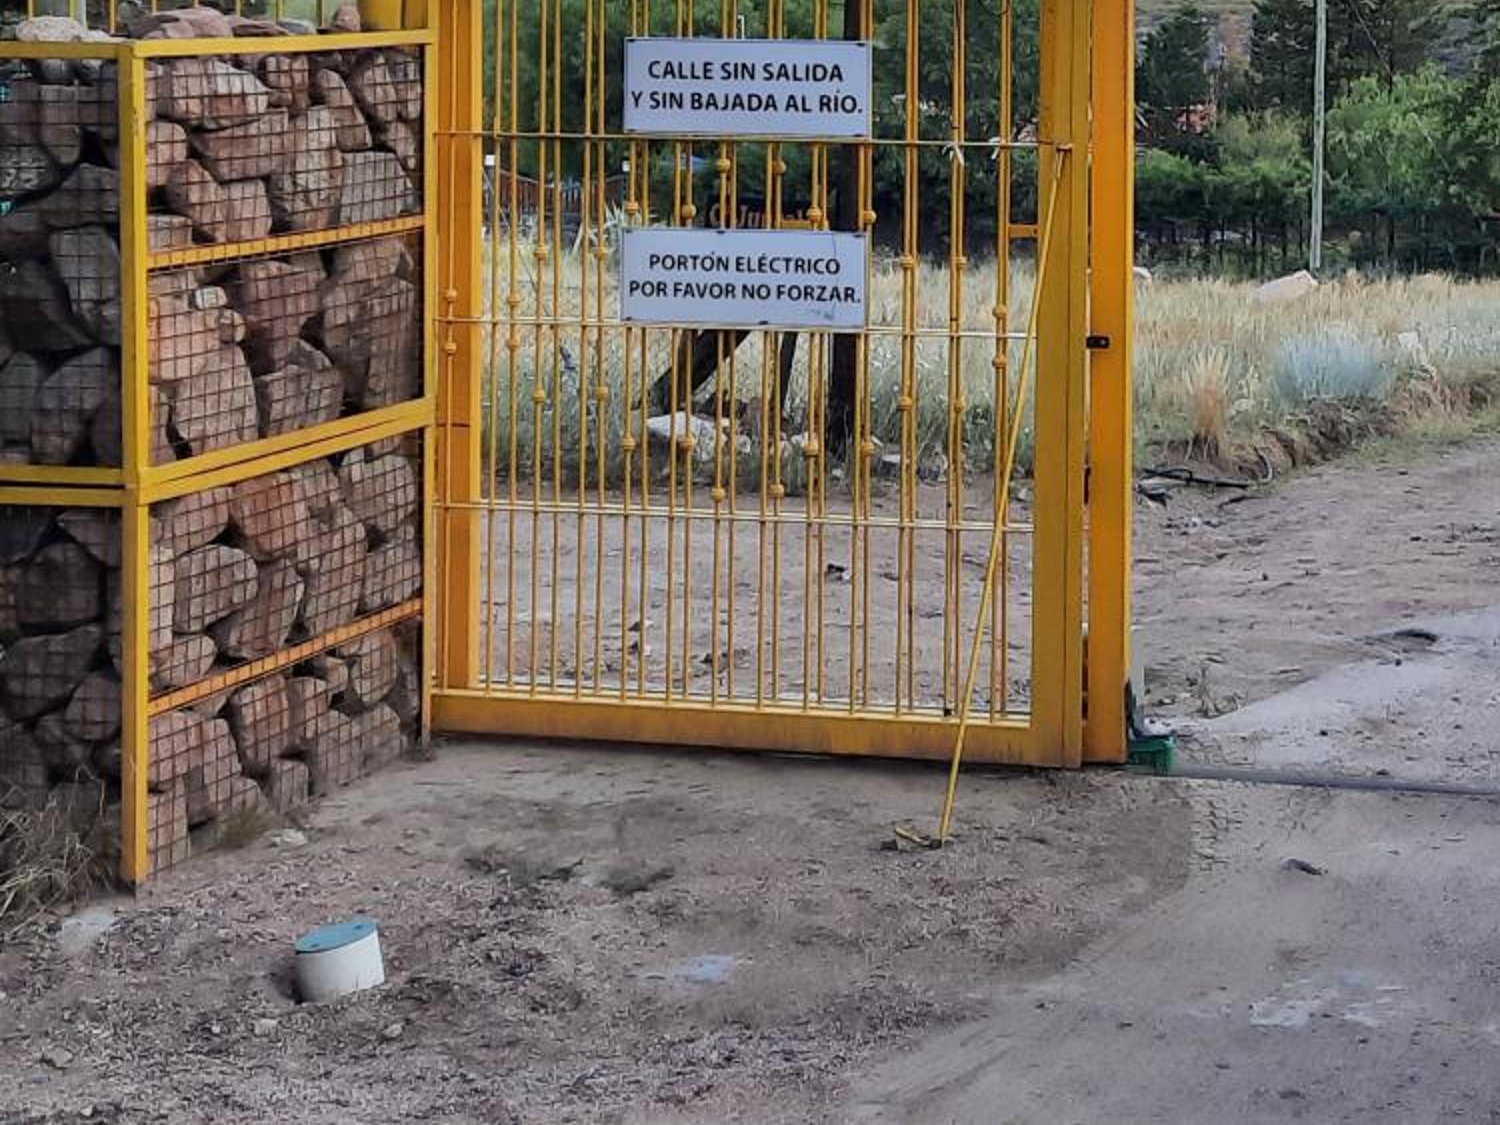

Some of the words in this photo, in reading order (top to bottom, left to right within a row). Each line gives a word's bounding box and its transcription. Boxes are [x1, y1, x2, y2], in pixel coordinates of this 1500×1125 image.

[648, 61, 713, 80] CALLE
[721, 62, 755, 80] SIN
[763, 63, 843, 82] SALIDA
[631, 91, 643, 108] Y
[650, 91, 683, 109] SIN
[691, 93, 778, 111] BAJADA
[785, 95, 812, 112] AL
[818, 89, 863, 113] RÍO.
[650, 251, 729, 271] PORTÓN
[736, 254, 840, 274] ELÉCTRICO
[630, 281, 667, 297] POR
[674, 282, 736, 299] FAVOR
[742, 284, 770, 300] NO
[777, 285, 860, 302] FORZAR.
